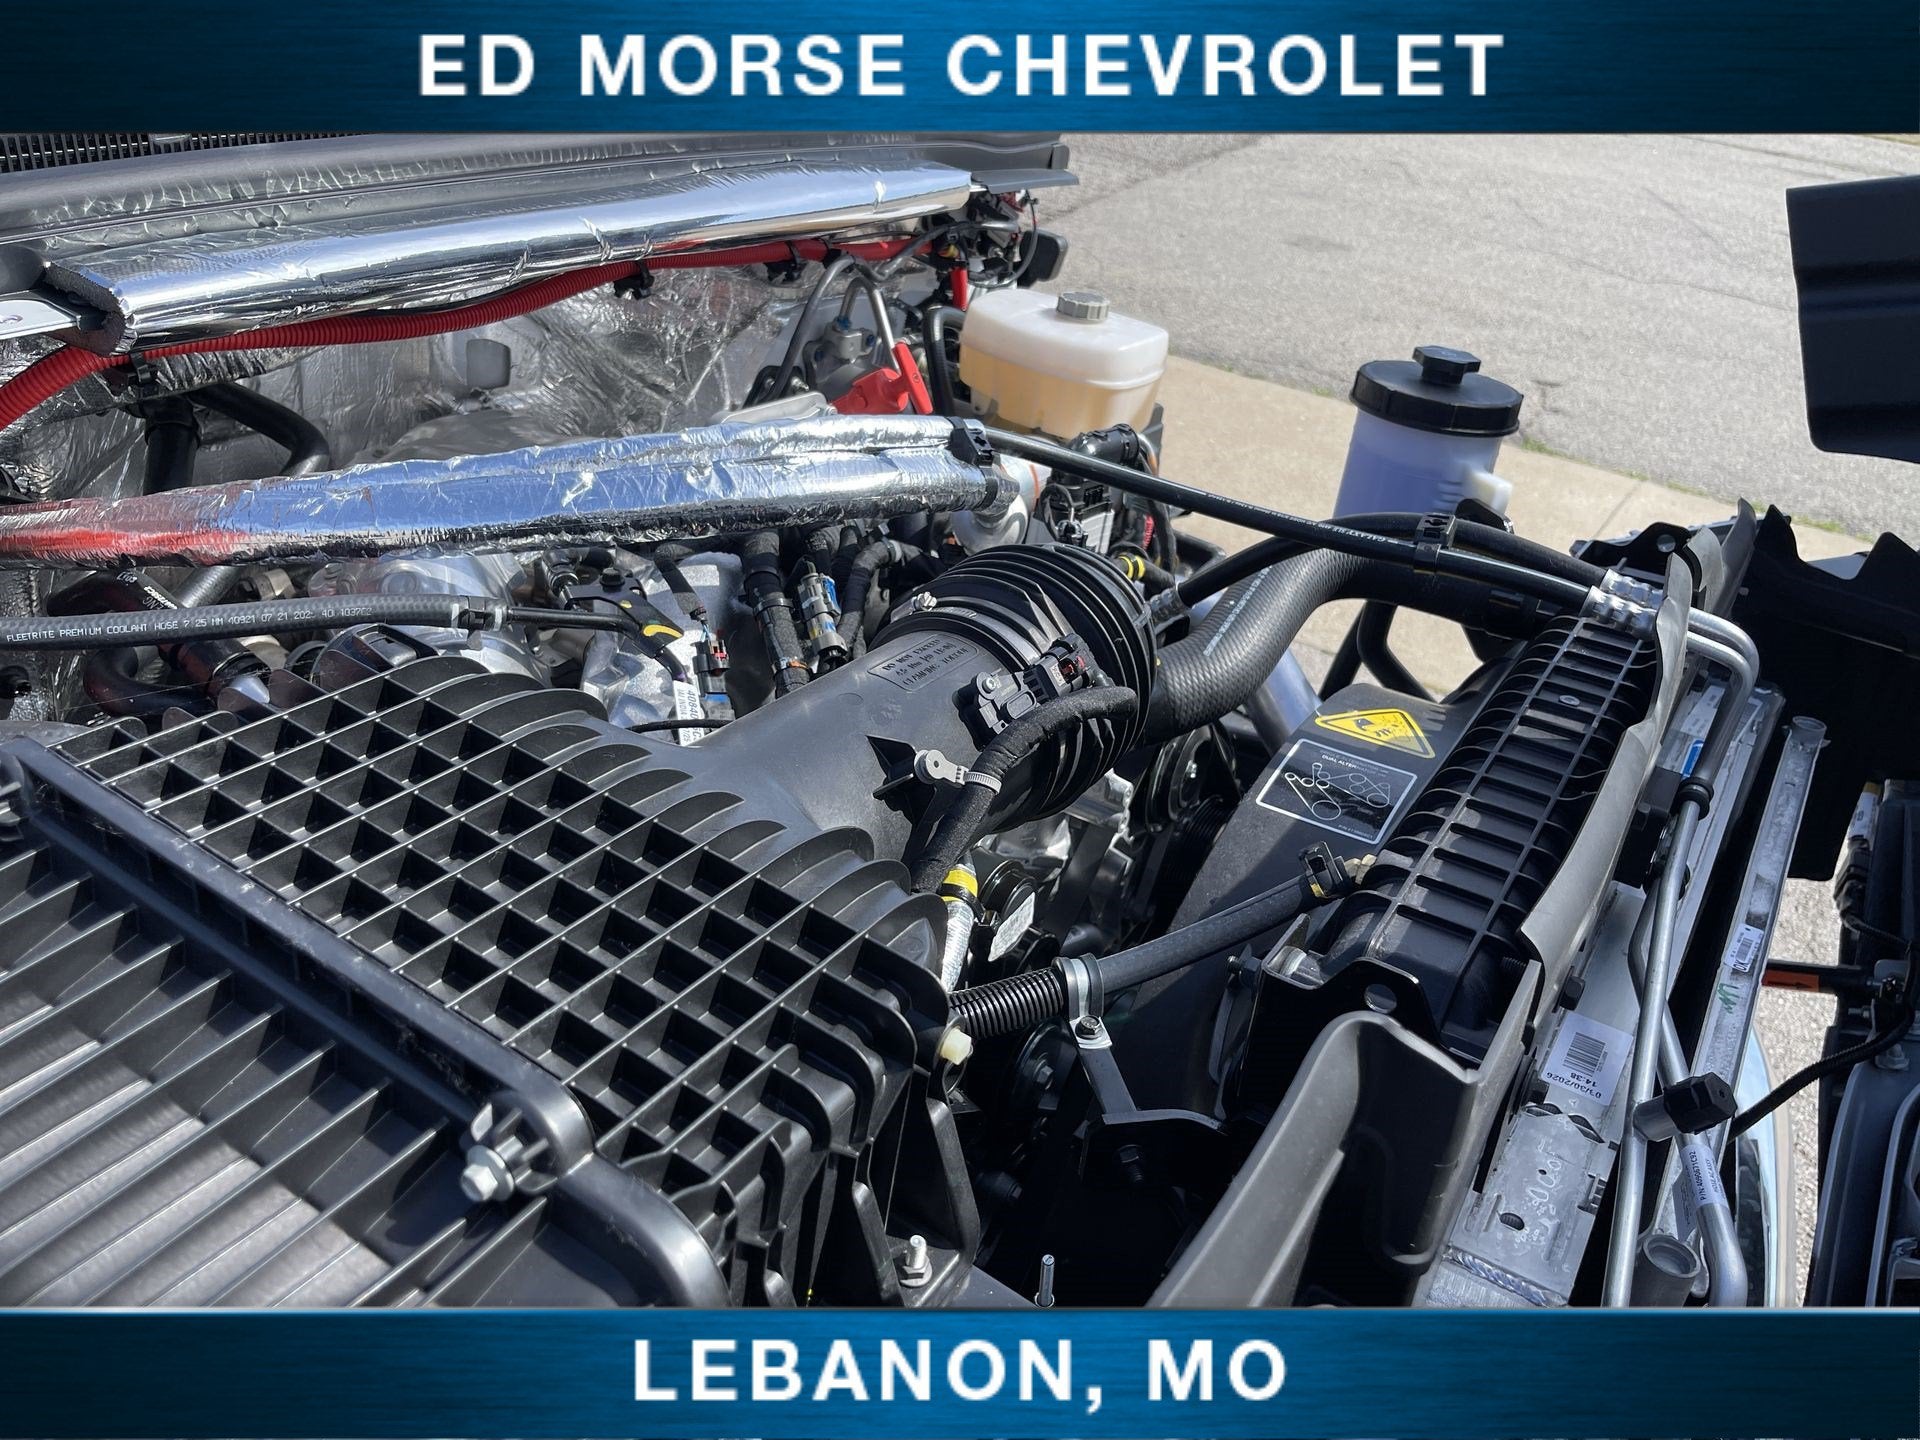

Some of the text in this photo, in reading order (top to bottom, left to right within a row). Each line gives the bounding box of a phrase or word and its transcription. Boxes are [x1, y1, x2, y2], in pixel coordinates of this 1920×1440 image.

[6, 630, 55, 643] FLEETRITE
[59, 627, 102, 638] PREMIUM
[106, 623, 147, 635] COOLANT
[154, 620, 179, 630] HOSE
[1546, 1072, 1602, 1099] 03/30/2026
[1570, 1072, 1598, 1088] 14:38
